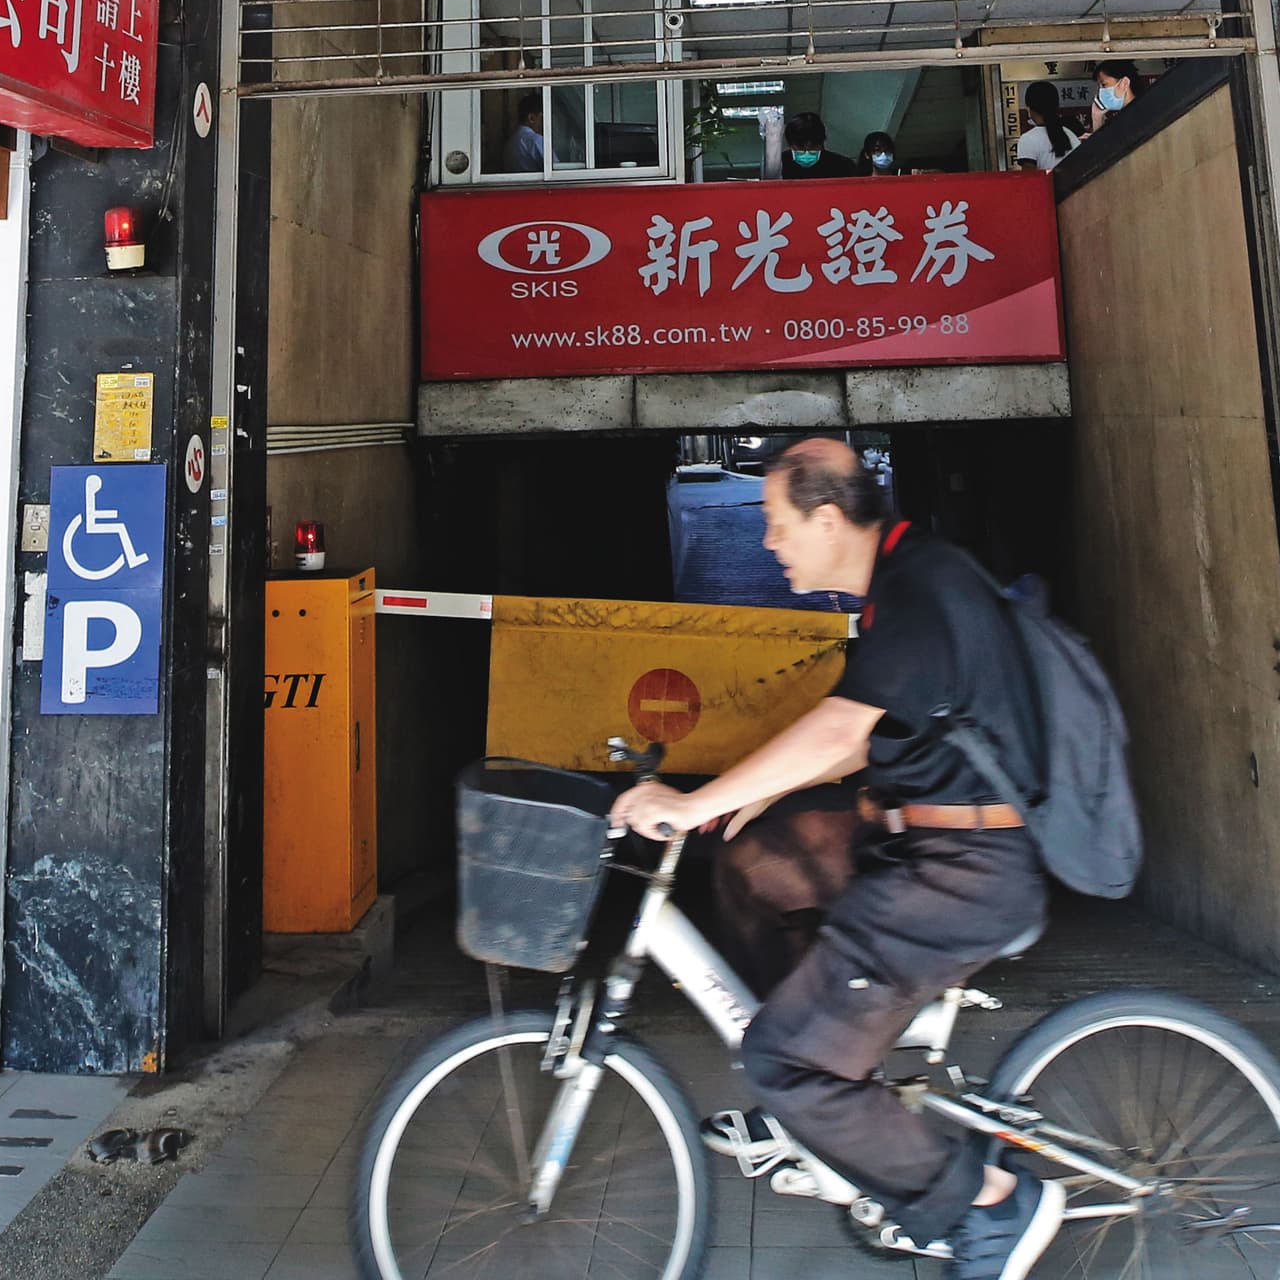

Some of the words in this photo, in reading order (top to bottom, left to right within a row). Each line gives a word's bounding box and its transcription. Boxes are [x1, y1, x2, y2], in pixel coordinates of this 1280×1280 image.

[95, 44, 143, 107] 十樓
[639, 200, 995, 297] 新光證券
[511, 280, 578, 298] SKIS
[511, 323, 753, 351] www.sk88.com.tw
[784, 314, 969, 340] 0800-85-99-88
[61, 600, 141, 703] P
